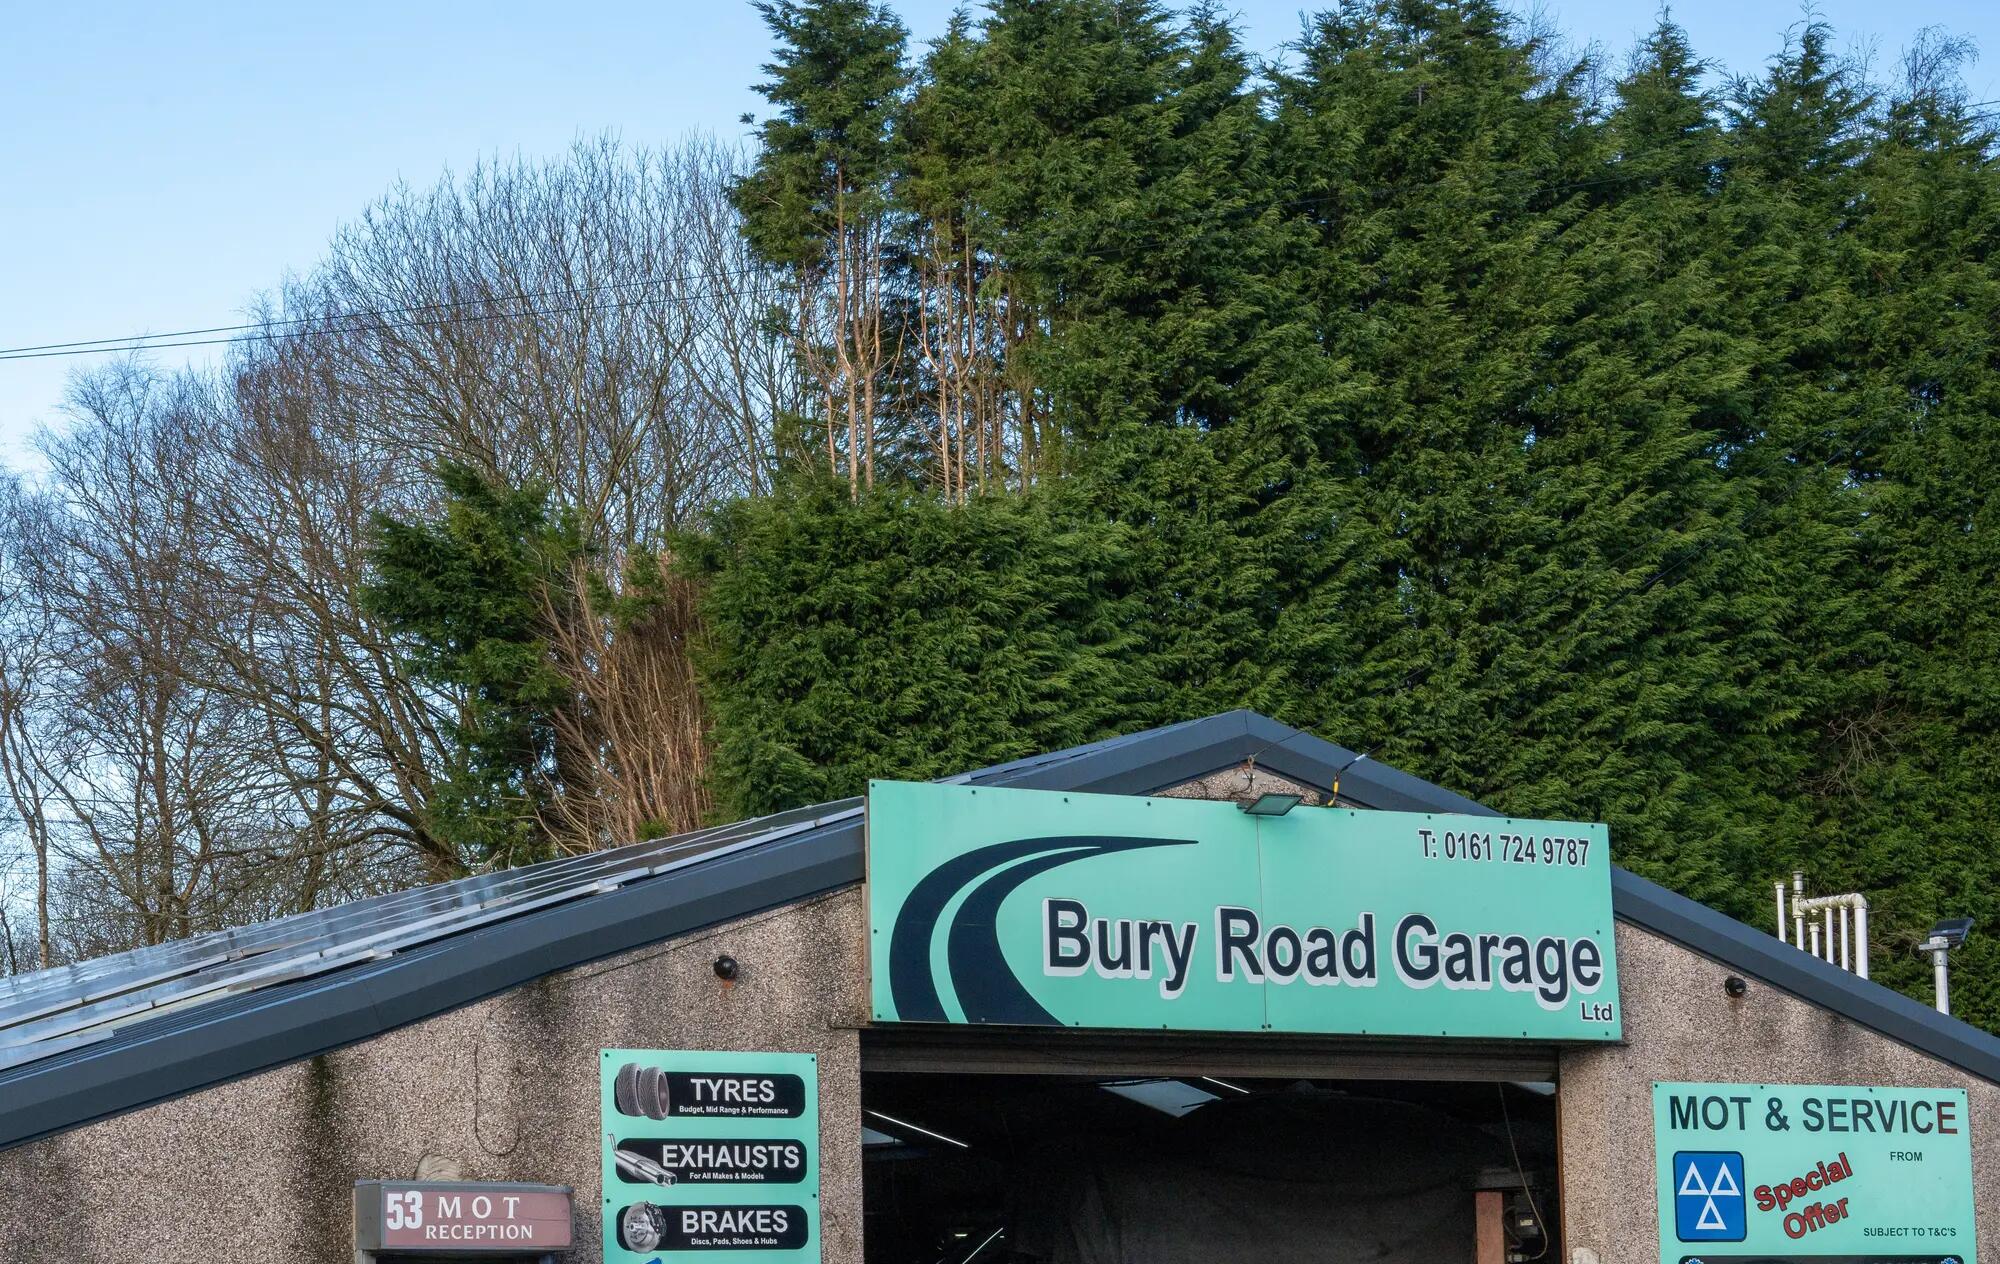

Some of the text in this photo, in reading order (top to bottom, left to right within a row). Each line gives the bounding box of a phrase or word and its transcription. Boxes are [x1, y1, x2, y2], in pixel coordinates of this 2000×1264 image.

[1419, 829, 1590, 868] T: 0161 724 9787
[1043, 897, 1603, 1011] Bury Road Garage
[1580, 1000, 1614, 1023] Ltd
[690, 1078, 775, 1103] TYRES
[679, 1105, 789, 1115] Budget, Mid Range & Performance
[1669, 1095, 1958, 1135] MOT & SERVICE
[662, 1144, 800, 1169] EXHAUSTS
[1890, 1151, 1923, 1162] FROM
[689, 1172, 765, 1180] For All Makes & Models
[1753, 1152, 1854, 1212] Special
[386, 1190, 423, 1230] 53
[682, 1209, 789, 1233] BRAKES
[1783, 1197, 1850, 1240] Offer
[425, 1224, 533, 1240] RECEPTION
[691, 1237, 778, 1246] Discs, Pads, Shoes & Hubs
[1863, 1227, 1957, 1237] SUBJECT TO T&C'S
